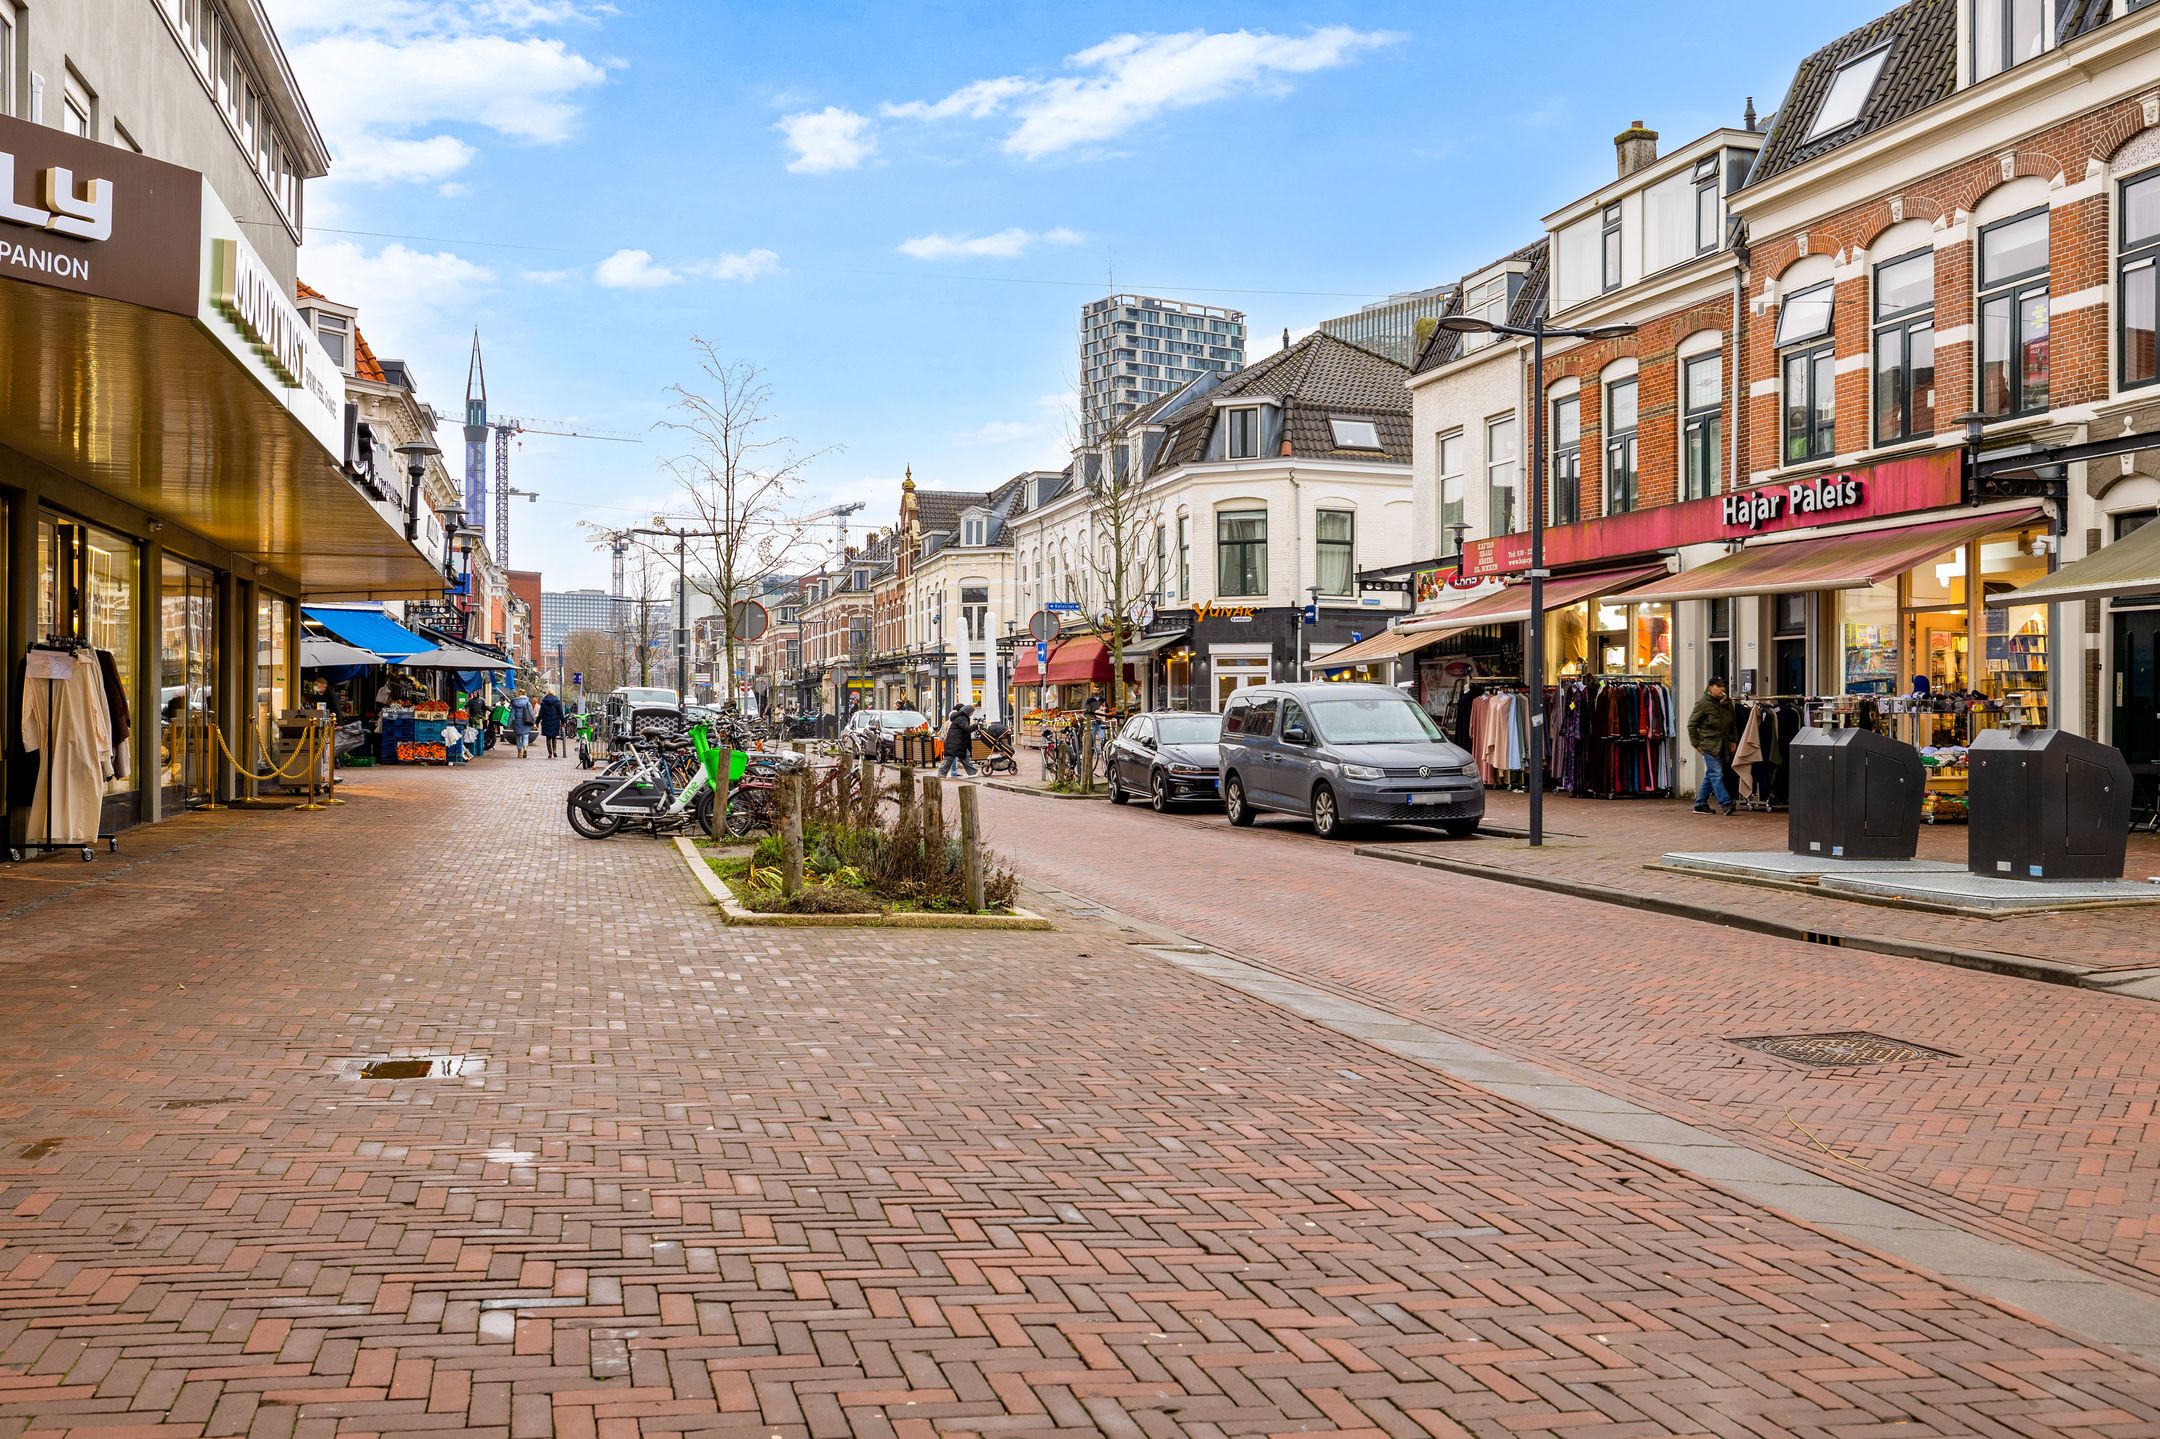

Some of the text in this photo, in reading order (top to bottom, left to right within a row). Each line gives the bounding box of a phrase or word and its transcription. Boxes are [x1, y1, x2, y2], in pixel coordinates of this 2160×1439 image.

[1722, 475, 1857, 530] Hajar Paleis
[679, 780, 699, 804] Lime
